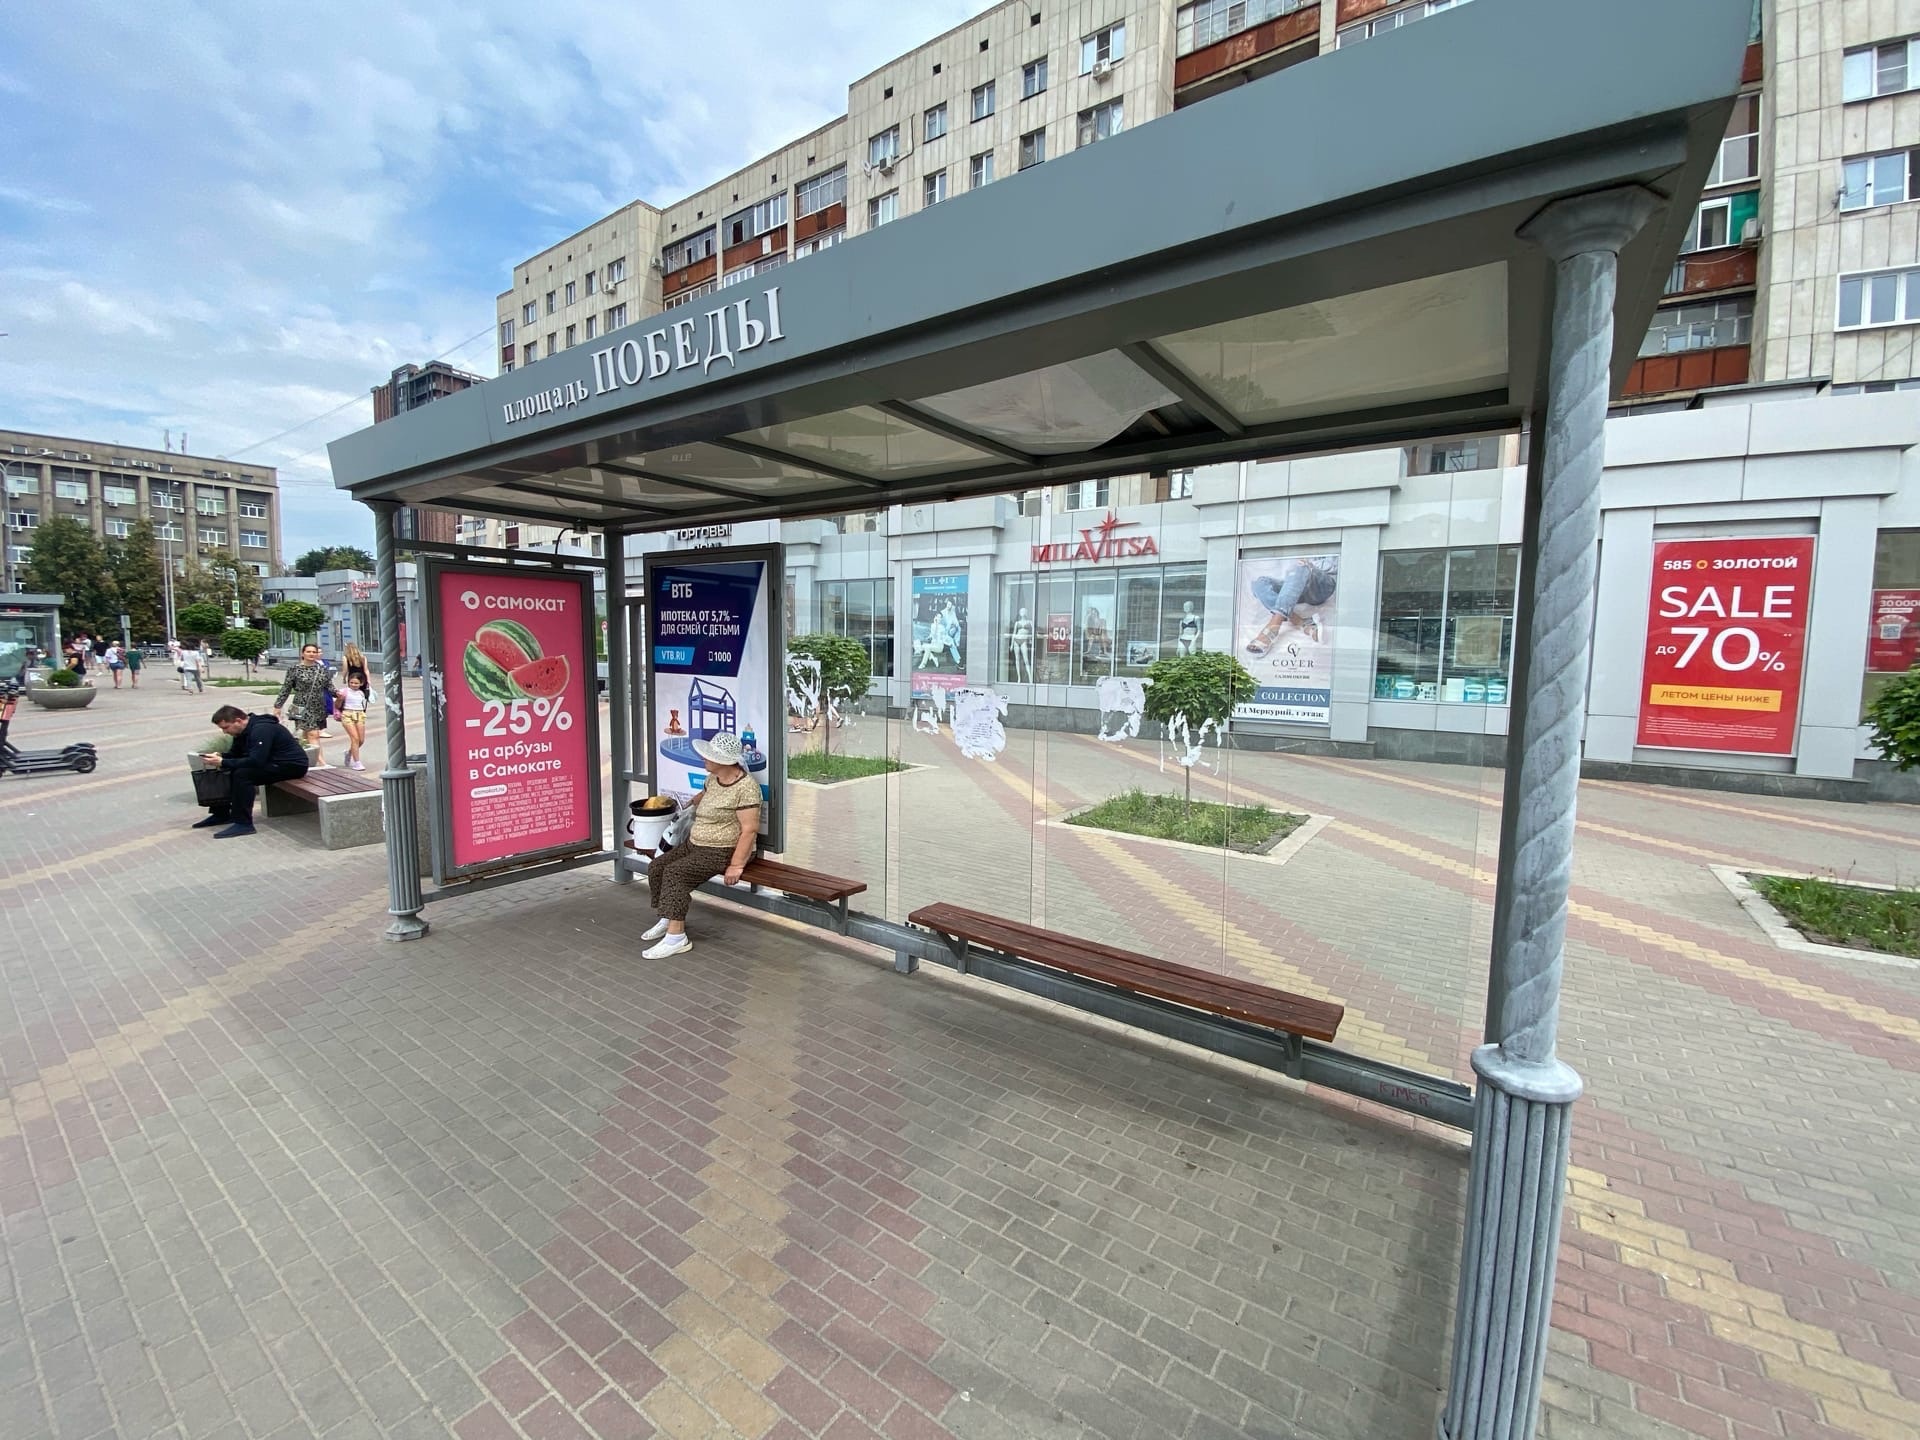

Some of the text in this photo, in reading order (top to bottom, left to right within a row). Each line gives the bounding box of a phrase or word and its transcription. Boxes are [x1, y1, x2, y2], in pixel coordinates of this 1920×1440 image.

[503, 286, 786, 424] площадь ПОБЕДЫ
[1663, 556, 1798, 570] 585 ЗОЛОТОЙ
[671, 583, 693, 599] ВТБ
[484, 595, 566, 612] самокат
[1659, 585, 1795, 619] SALE
[660, 610, 697, 622] ИПОТЕКА
[698, 610, 709, 621] ОТ
[711, 610, 731, 623] 5,7%
[660, 622, 740, 637] ДЛЯ СЕМЕЙ С ДЕТЬМИ
[661, 650, 685, 661] VTB.RU
[713, 651, 732, 662] 1000
[1670, 627, 1786, 672] 70%
[1272, 659, 1314, 668] COVER
[1261, 691, 1326, 703] COLLECTION
[1660, 690, 1770, 704] ЛЕТОМ ЦЕНЫ НИЖЕ
[465, 697, 573, 737] -25%
[468, 740, 552, 760] на арбузы
[469, 759, 562, 780] в Самокате
